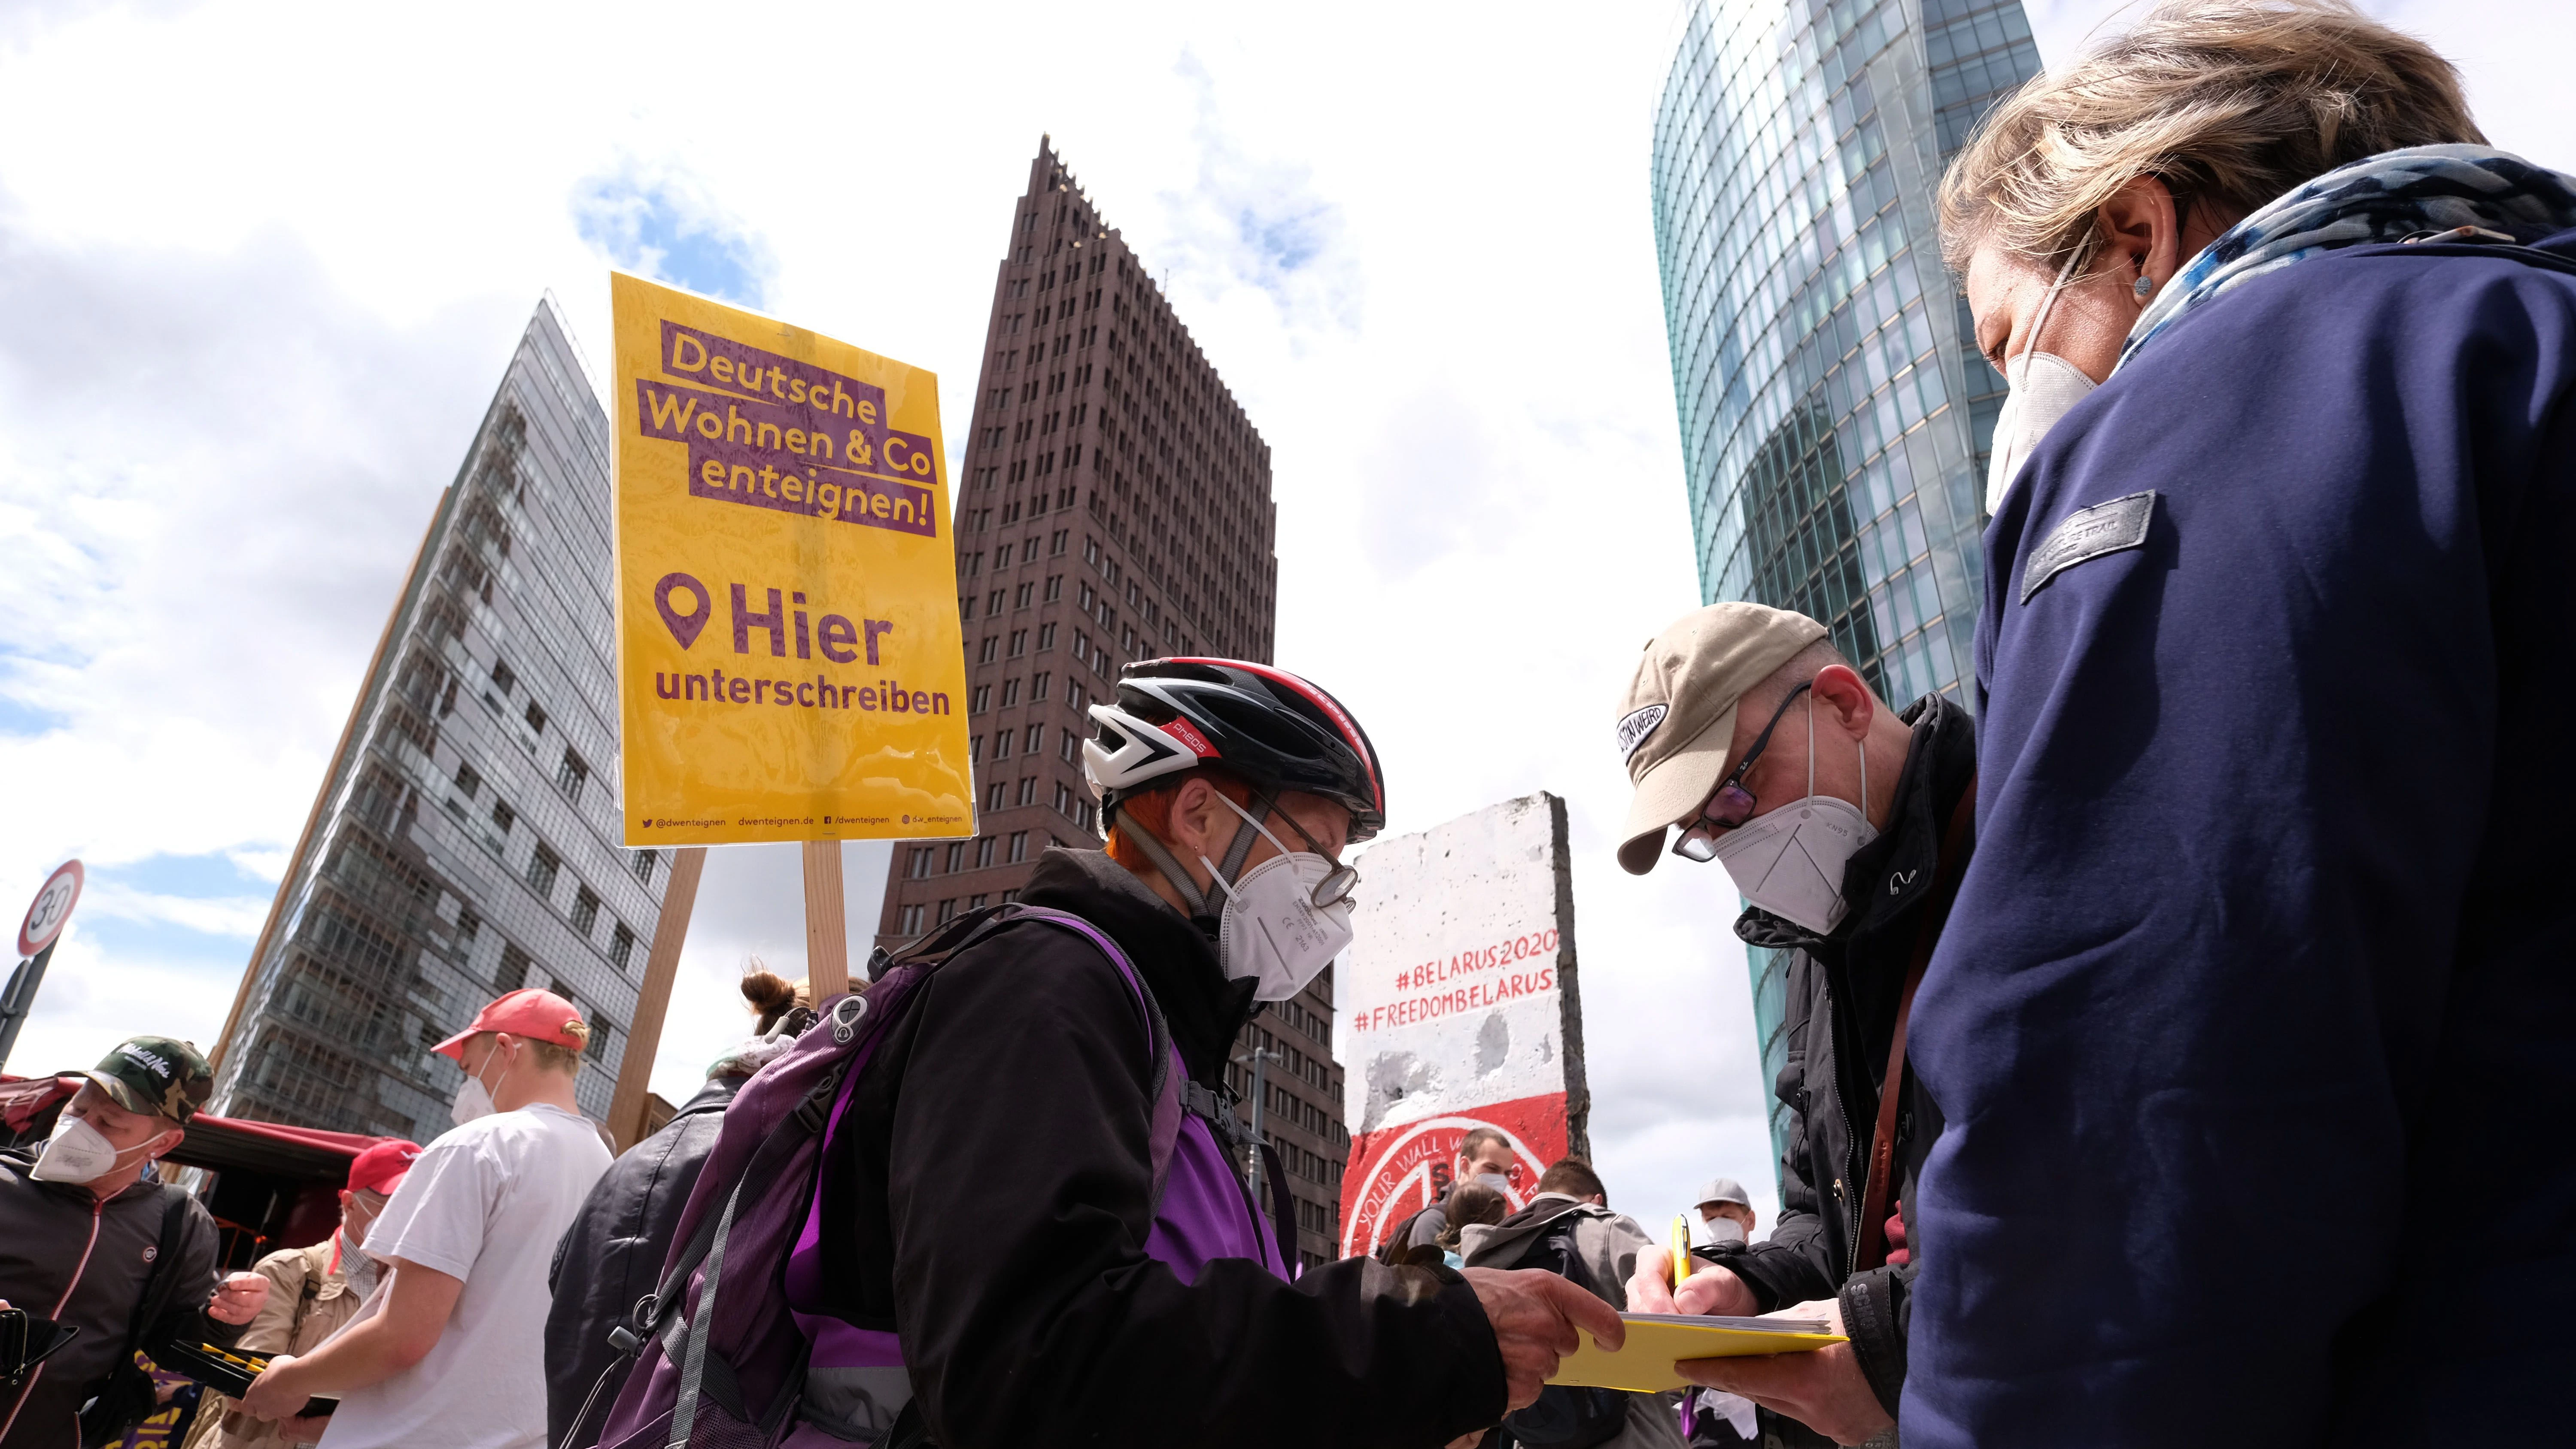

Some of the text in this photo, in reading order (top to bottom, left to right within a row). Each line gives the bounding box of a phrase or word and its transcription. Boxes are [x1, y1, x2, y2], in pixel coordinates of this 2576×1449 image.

[671, 333, 877, 425] Deutsche
[646, 389, 931, 475] Wohnen & Co
[702, 459, 929, 526] enteignen!
[730, 582, 893, 666] Hier
[656, 669, 950, 716] unterschreiben
[1633, 707, 1662, 735] WEIRD
[656, 815, 962, 829] @dwenteignen dwenteignen.de /dwenteignen dw_enteignen
[1826, 822, 1848, 837] KN95
[31, 884, 70, 930] 30
[1295, 935, 1309, 952] 2163
[1396, 929, 1560, 993] #BELARUS2020
[1355, 969, 1553, 1032] #FREEDOMBELARUS
[1358, 1171, 1396, 1233] YOUR
[1396, 1136, 1441, 1173] WALL
